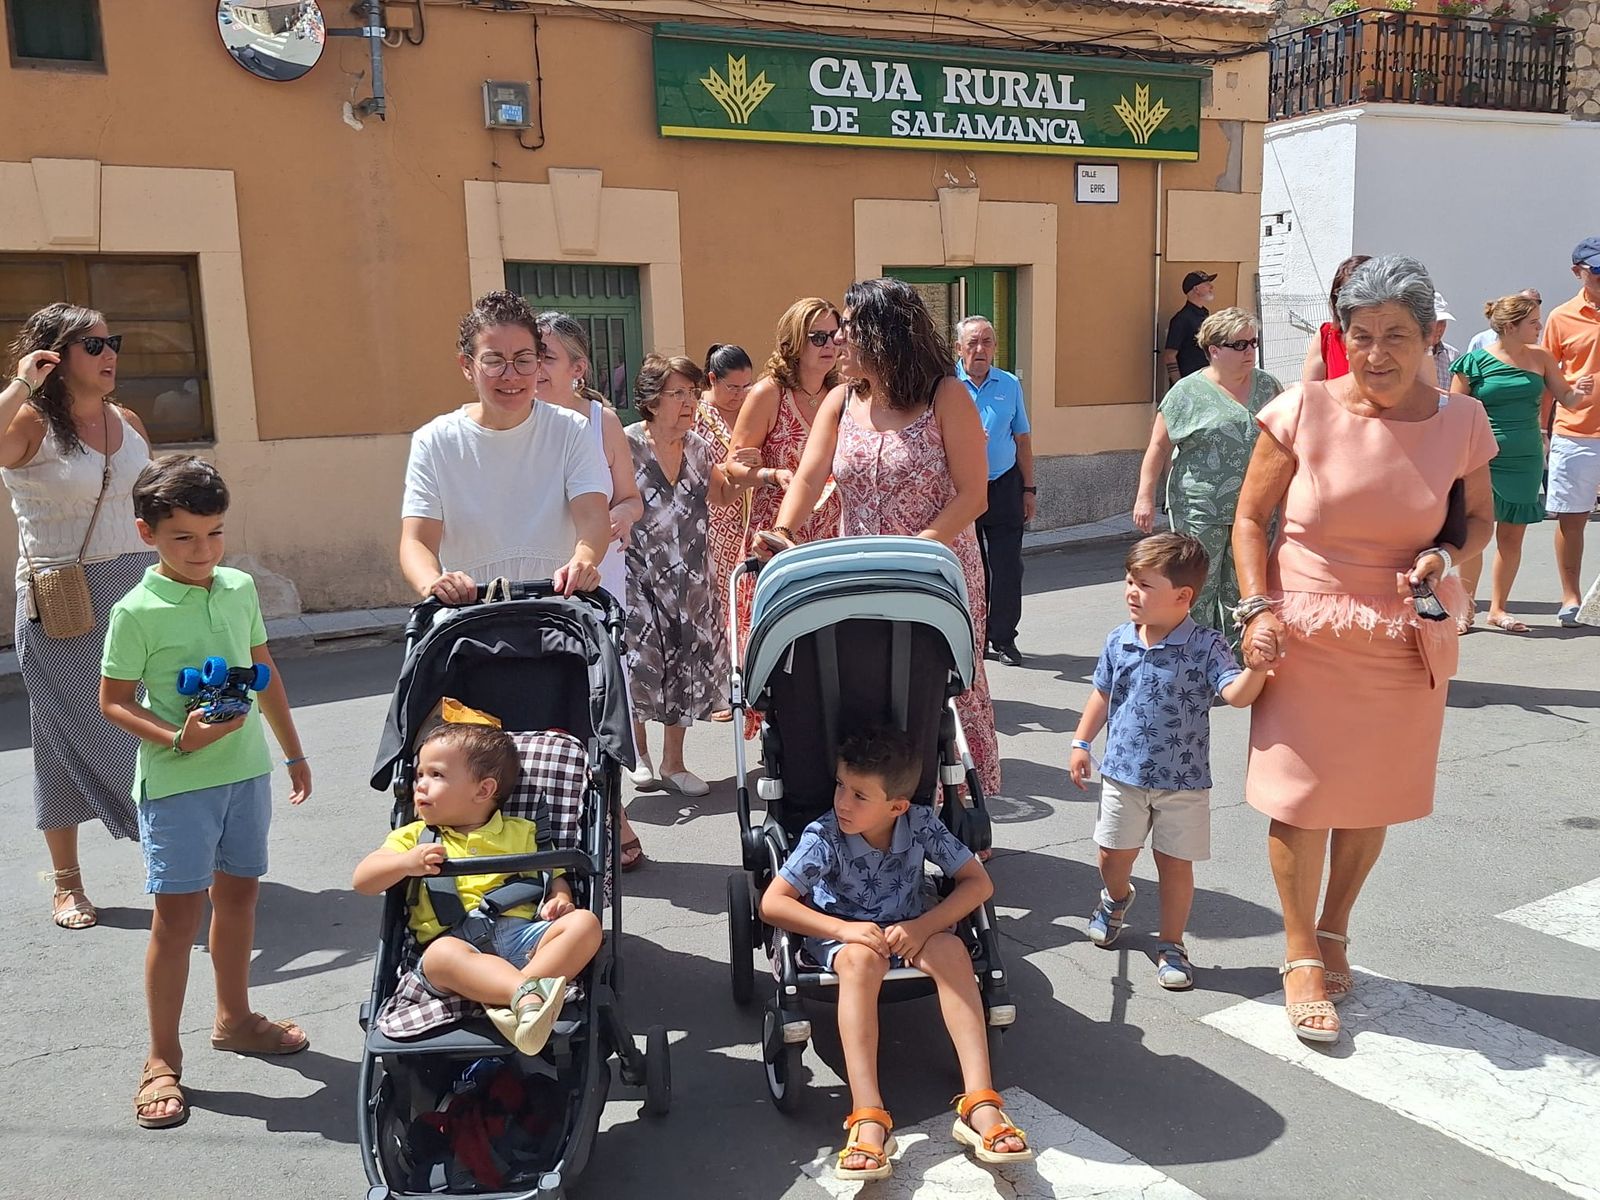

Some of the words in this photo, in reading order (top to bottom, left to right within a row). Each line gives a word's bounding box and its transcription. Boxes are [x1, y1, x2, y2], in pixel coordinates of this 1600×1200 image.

[809, 57, 922, 103] CAJA
[943, 66, 1085, 111] RURAL
[810, 105, 859, 134] DE
[891, 110, 1085, 144] SALAMANCA
[1081, 170, 1097, 178] CALLE
[1090, 184, 1105, 194] ERAS
